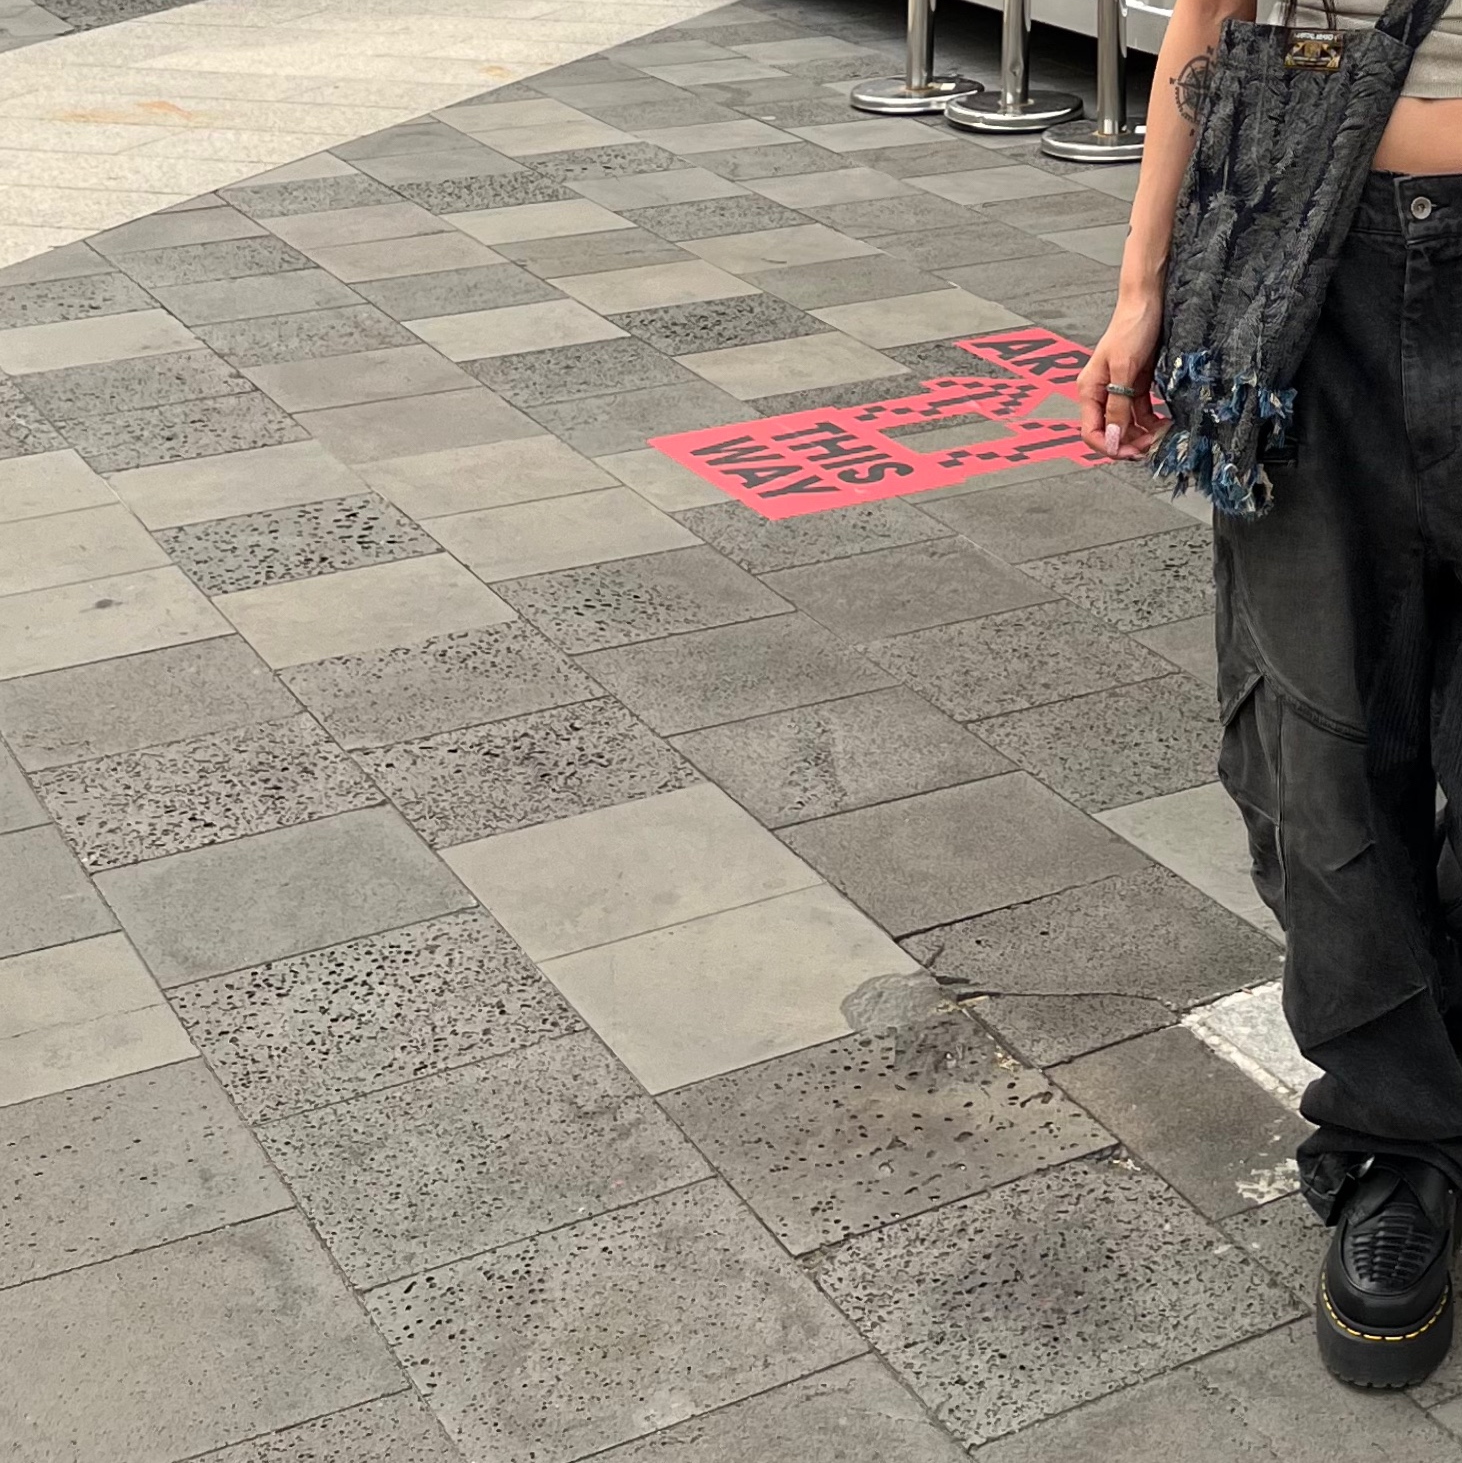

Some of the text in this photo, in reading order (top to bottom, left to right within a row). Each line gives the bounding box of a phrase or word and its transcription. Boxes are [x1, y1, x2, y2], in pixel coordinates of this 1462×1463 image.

[973, 337, 1093, 385] AR
[690, 434, 841, 499] WAY
[773, 420, 914, 485] THIS
